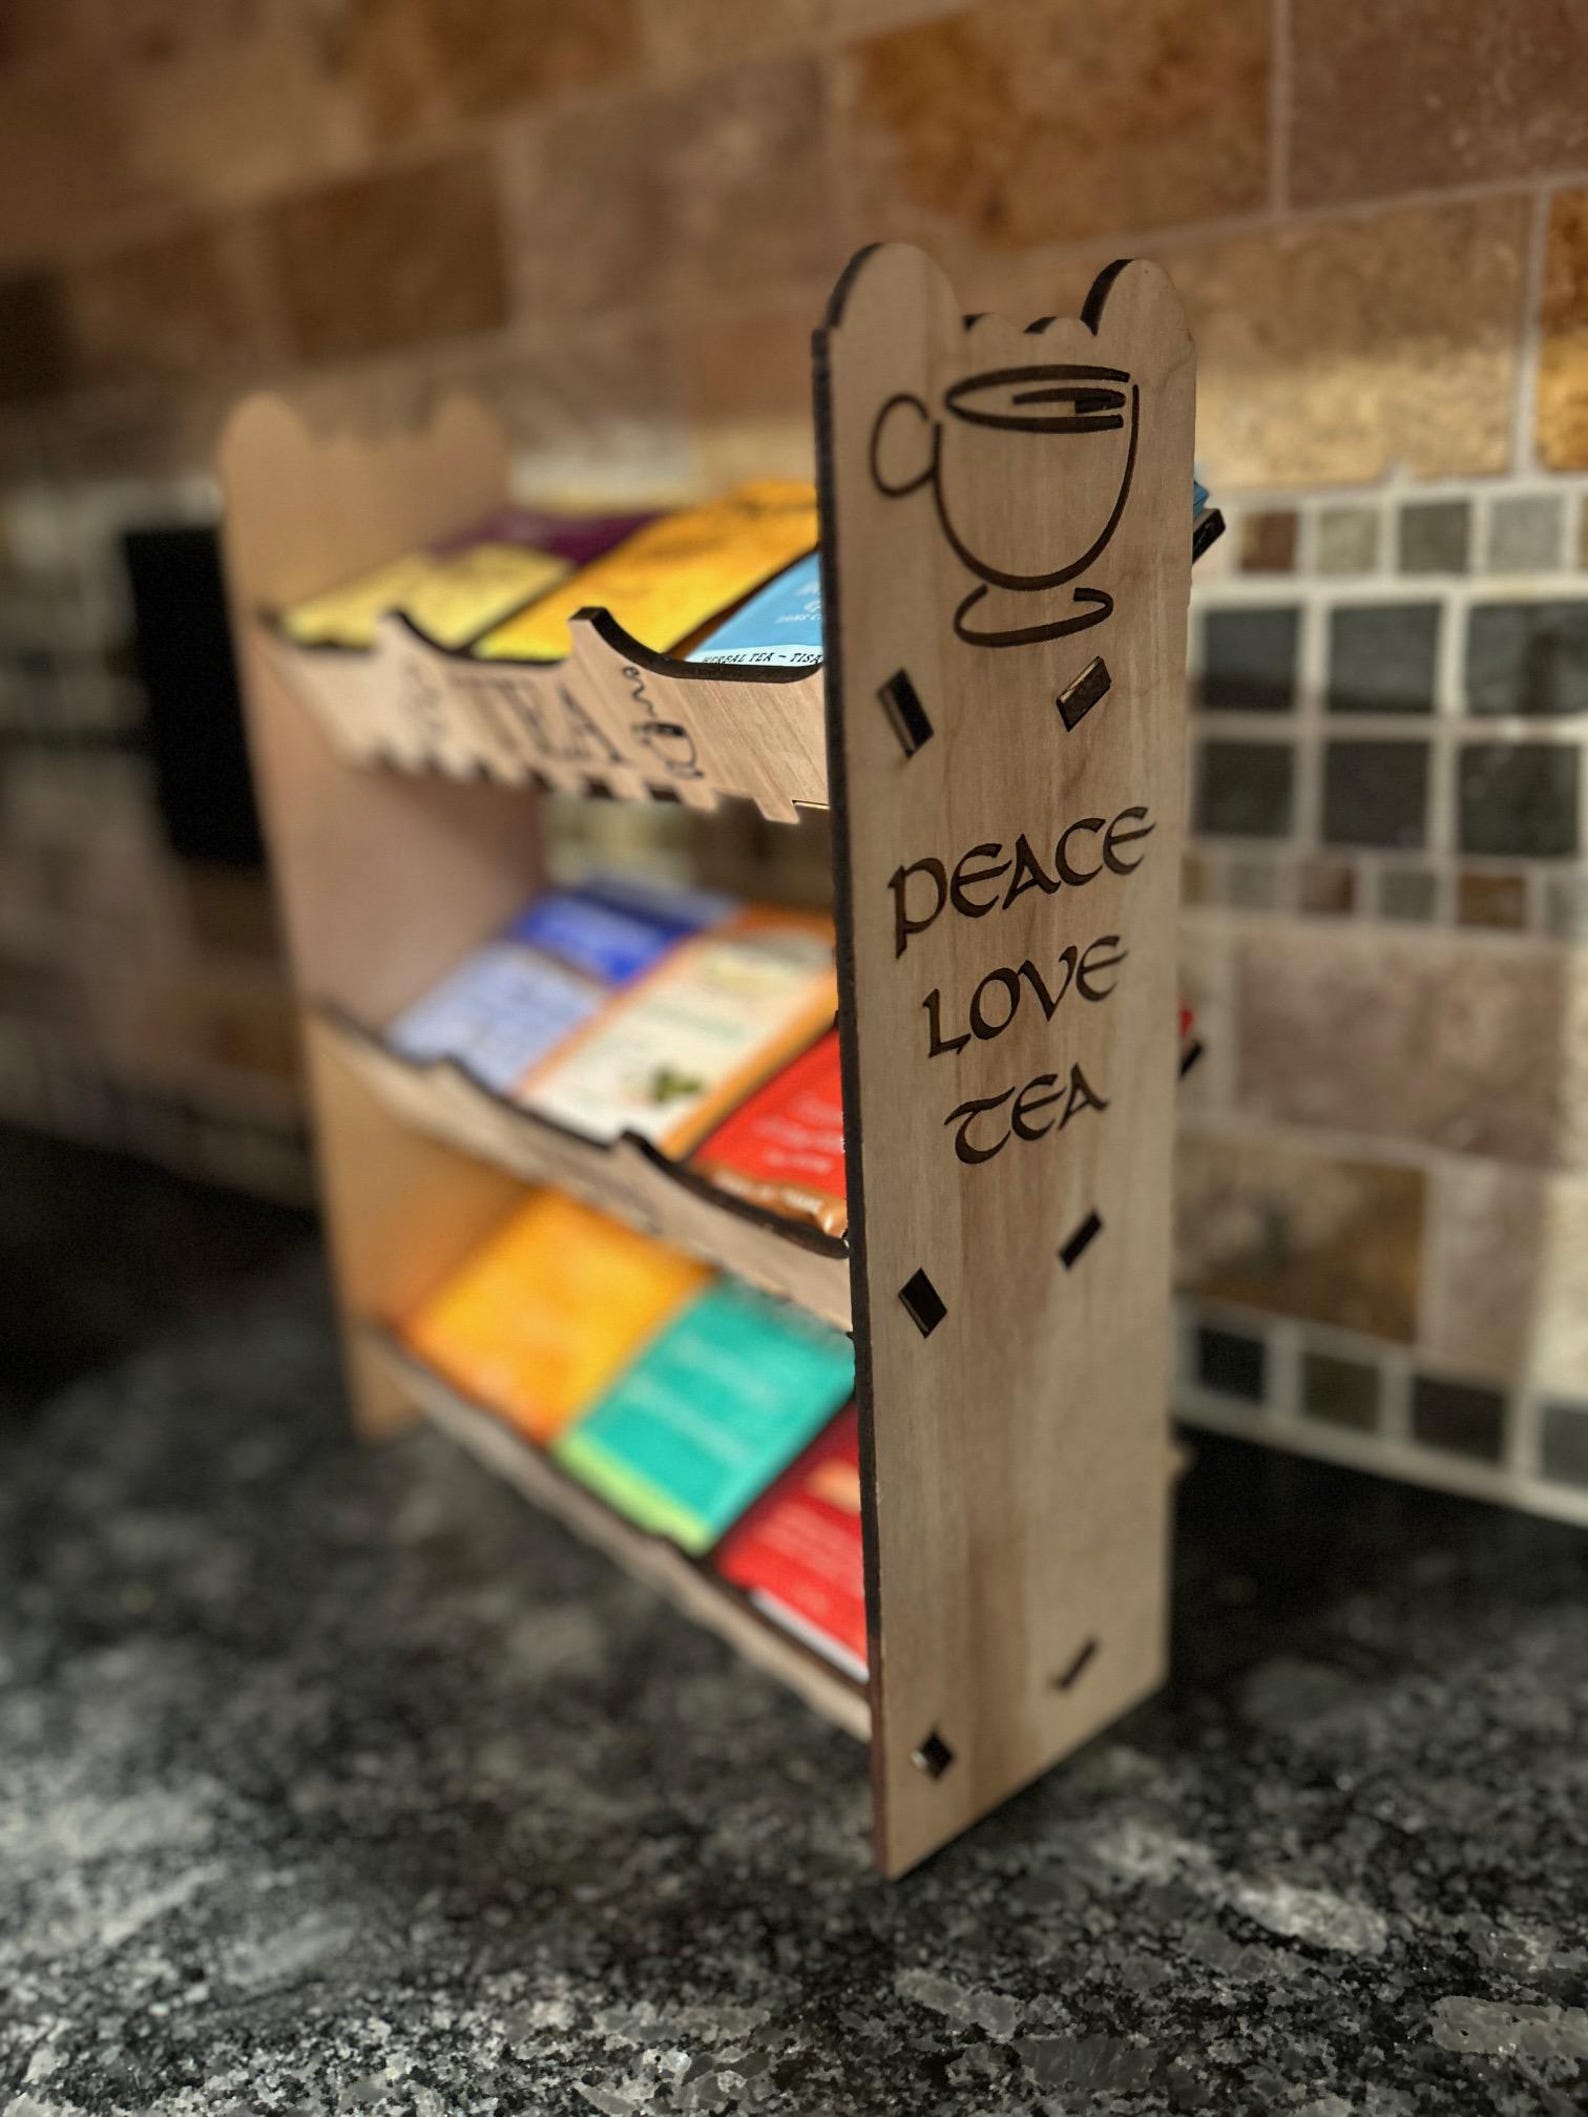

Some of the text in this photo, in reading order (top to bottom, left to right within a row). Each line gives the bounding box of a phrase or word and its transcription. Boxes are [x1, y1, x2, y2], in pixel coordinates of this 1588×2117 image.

[749, 652, 775, 662] TEA
[887, 806, 1156, 959] PEACE
[922, 935, 1128, 1058] LOVE
[944, 1063, 1108, 1164] TEA
